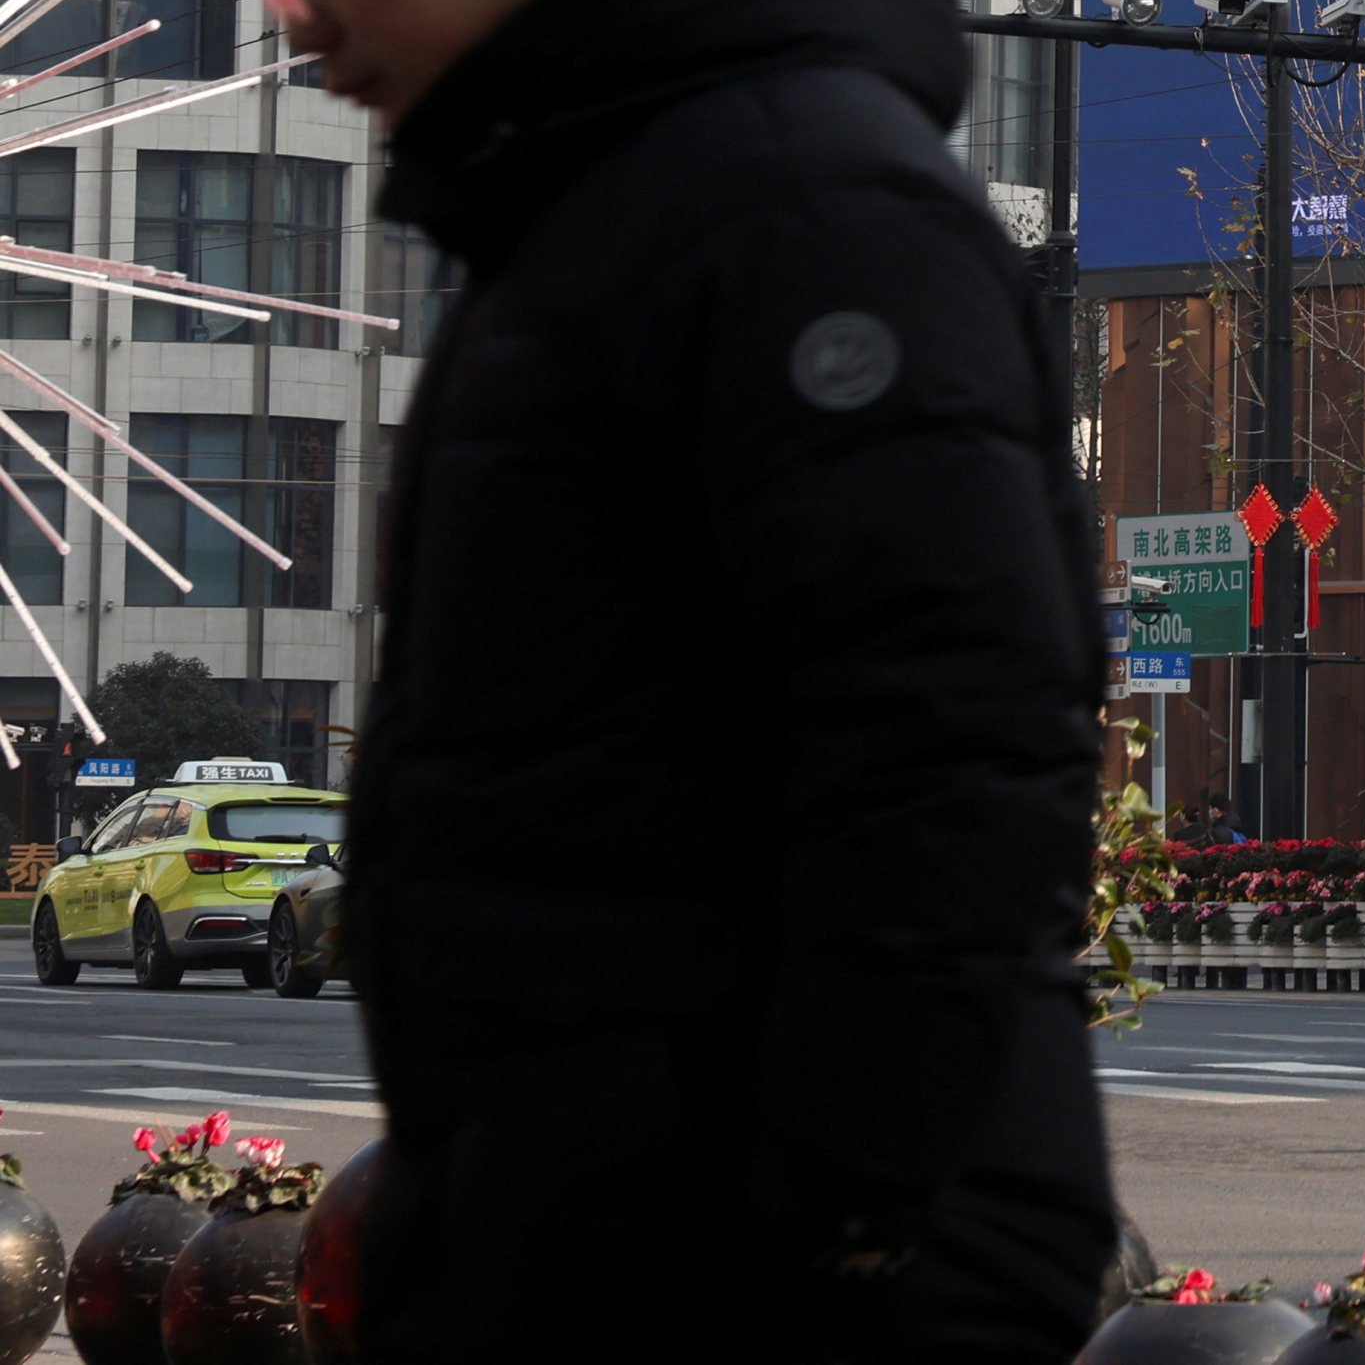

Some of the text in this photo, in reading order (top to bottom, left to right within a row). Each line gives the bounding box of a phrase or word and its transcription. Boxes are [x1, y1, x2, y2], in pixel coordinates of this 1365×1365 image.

[1133, 524, 1233, 558] 南北高架路
[1133, 657, 1164, 674] 西路
